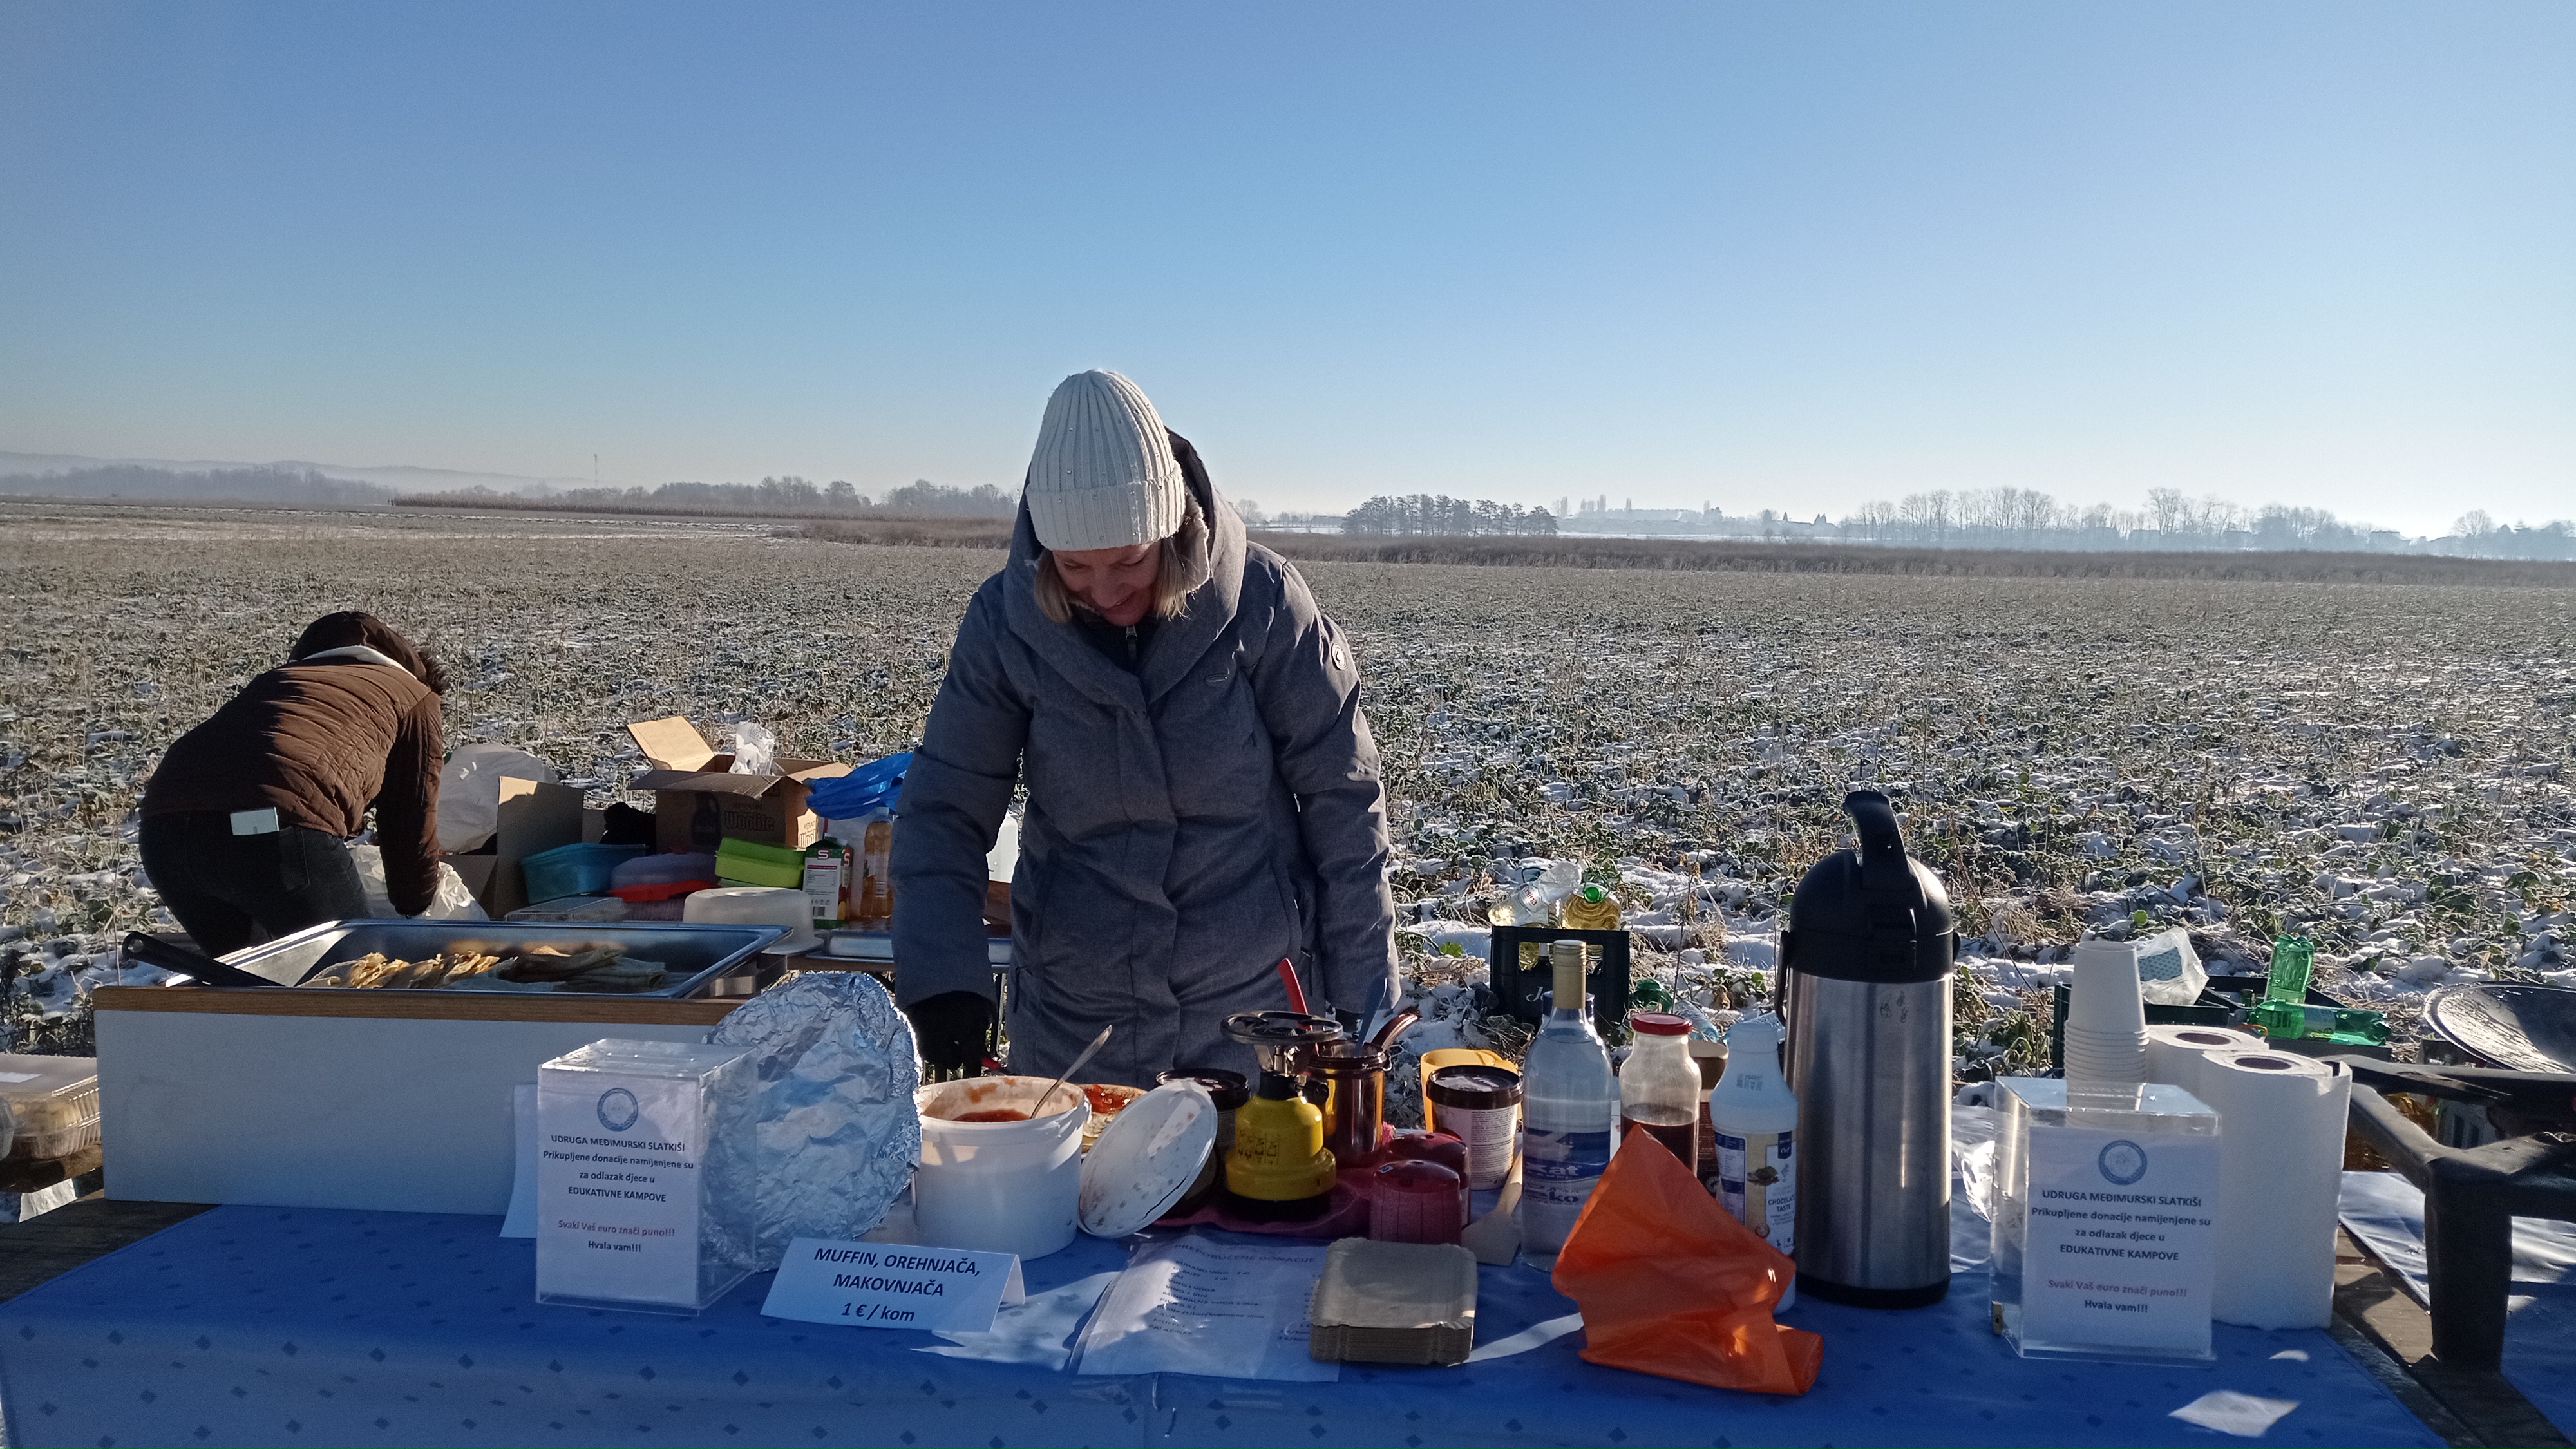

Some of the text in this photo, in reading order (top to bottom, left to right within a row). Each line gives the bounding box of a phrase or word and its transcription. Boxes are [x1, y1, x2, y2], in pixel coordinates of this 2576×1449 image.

[724, 811, 774, 831] Woolite
[551, 1135, 685, 1151] UDRUGA MEĐIMURSKI SLATKIŠI
[543, 1151, 590, 1162] Prikupljene
[592, 1153, 628, 1165] donacije
[630, 1157, 681, 1168] namijenjene
[591, 1171, 623, 1181] odlazak
[626, 1173, 647, 1184] djece
[568, 1186, 666, 1202] EDUKATIVNE KAMPOVE
[2042, 1189, 2202, 1207] UDRUGA MEĐIMURSKI SLATKIŠI
[1776, 1204, 1792, 1212] TASTE
[2032, 1208, 2088, 1220] Prikupljene
[2090, 1211, 2132, 1222] donacije
[2135, 1213, 2196, 1226] namijenjene
[558, 1220, 580, 1230] Svaki
[581, 1221, 596, 1231] Vaš
[619, 1226, 639, 1236] znači
[642, 1228, 675, 1237] puno!!!
[2089, 1229, 2126, 1240] odlazak
[2130, 1231, 2155, 1243] djece
[588, 1241, 641, 1252] Hvala vam!!!
[2060, 1244, 2179, 1260] EDUKATIVNE KAMPOVE
[814, 1247, 980, 1277] MUFFIN, OREHNJAČA,
[1175, 1260, 1208, 1273] KUHANO
[833, 1274, 943, 1296] MAKOVNJAČA
[1166, 1285, 1186, 1294] VINO
[1169, 1278, 1188, 1288] VINO
[2047, 1279, 2186, 1298] Svaki Vaš euro znači puno!!!
[1162, 1291, 1209, 1305] MINERALNA
[2084, 1300, 2148, 1312] Hvala vam!!!
[841, 1302, 915, 1321] 1 € / kom
